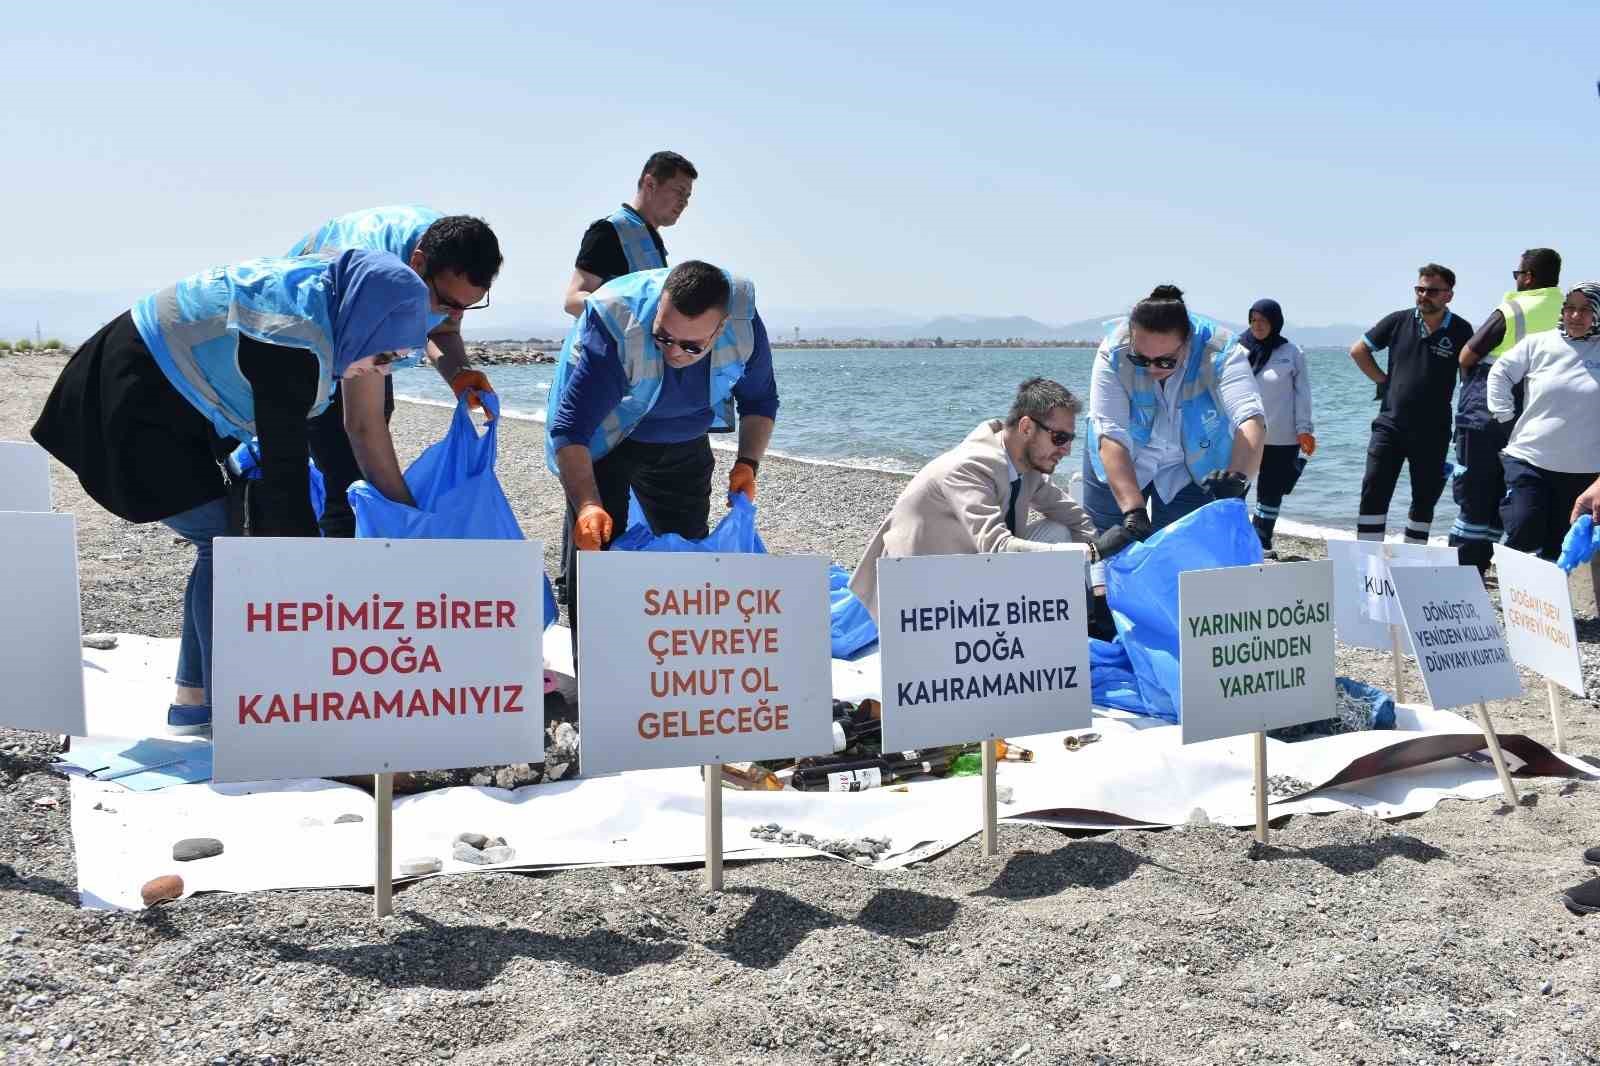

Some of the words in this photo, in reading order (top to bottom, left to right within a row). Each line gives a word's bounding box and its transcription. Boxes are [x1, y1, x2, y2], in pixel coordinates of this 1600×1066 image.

[247, 593, 404, 632] HEPİMİZ
[416, 592, 516, 630] BİRER
[644, 583, 731, 616] SAHİP
[736, 589, 782, 624] ÇIK
[900, 598, 1000, 633] HEPİMİZ
[1006, 594, 1070, 625] BİRER
[1188, 609, 1262, 638] YARININ
[1267, 600, 1330, 629] DOĞASI
[648, 628, 779, 665] ÇEVREYE
[955, 631, 1025, 665] DOĞA
[1212, 635, 1312, 668] BUGÜNDEN
[1414, 625, 1462, 648] YENİDEN
[331, 637, 442, 676] DOĞA
[1425, 651, 1472, 673] DÜNYAYI
[650, 668, 734, 698] UMUT
[741, 667, 779, 693] OL
[897, 665, 1078, 707] KAHRAMANIYIZ
[1219, 666, 1306, 699] YARATILIR
[239, 685, 524, 725] KAHRAMANIYIZ
[638, 699, 789, 740] GELECEĞE
